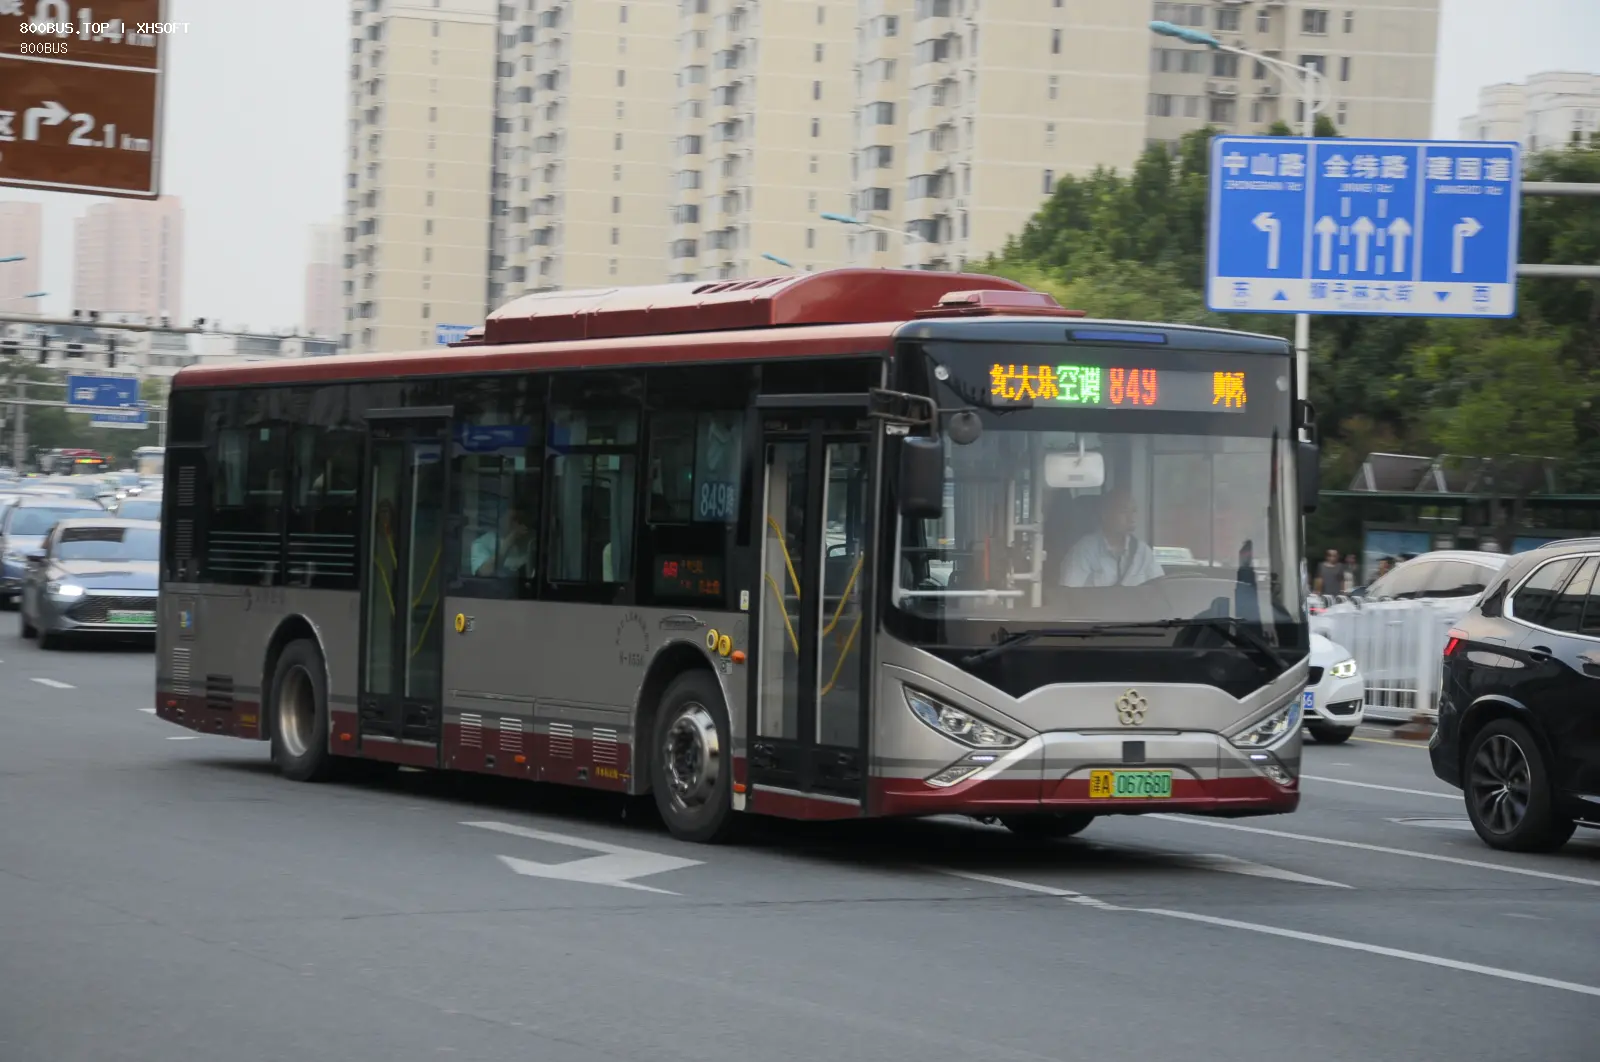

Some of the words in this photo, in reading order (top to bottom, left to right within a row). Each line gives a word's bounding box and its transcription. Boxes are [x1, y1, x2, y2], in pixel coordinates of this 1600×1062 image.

[68, 113, 116, 148] 2.1
[120, 133, 151, 152] km
[1222, 151, 1305, 177] 中山路
[1323, 154, 1408, 179] 金纬路
[1426, 156, 1512, 181] 建国道
[1056, 365, 1101, 404] 空调
[1109, 368, 1156, 405] 849
[1091, 774, 1110, 794] 津A
[1117, 774, 1170, 794] 06768D
